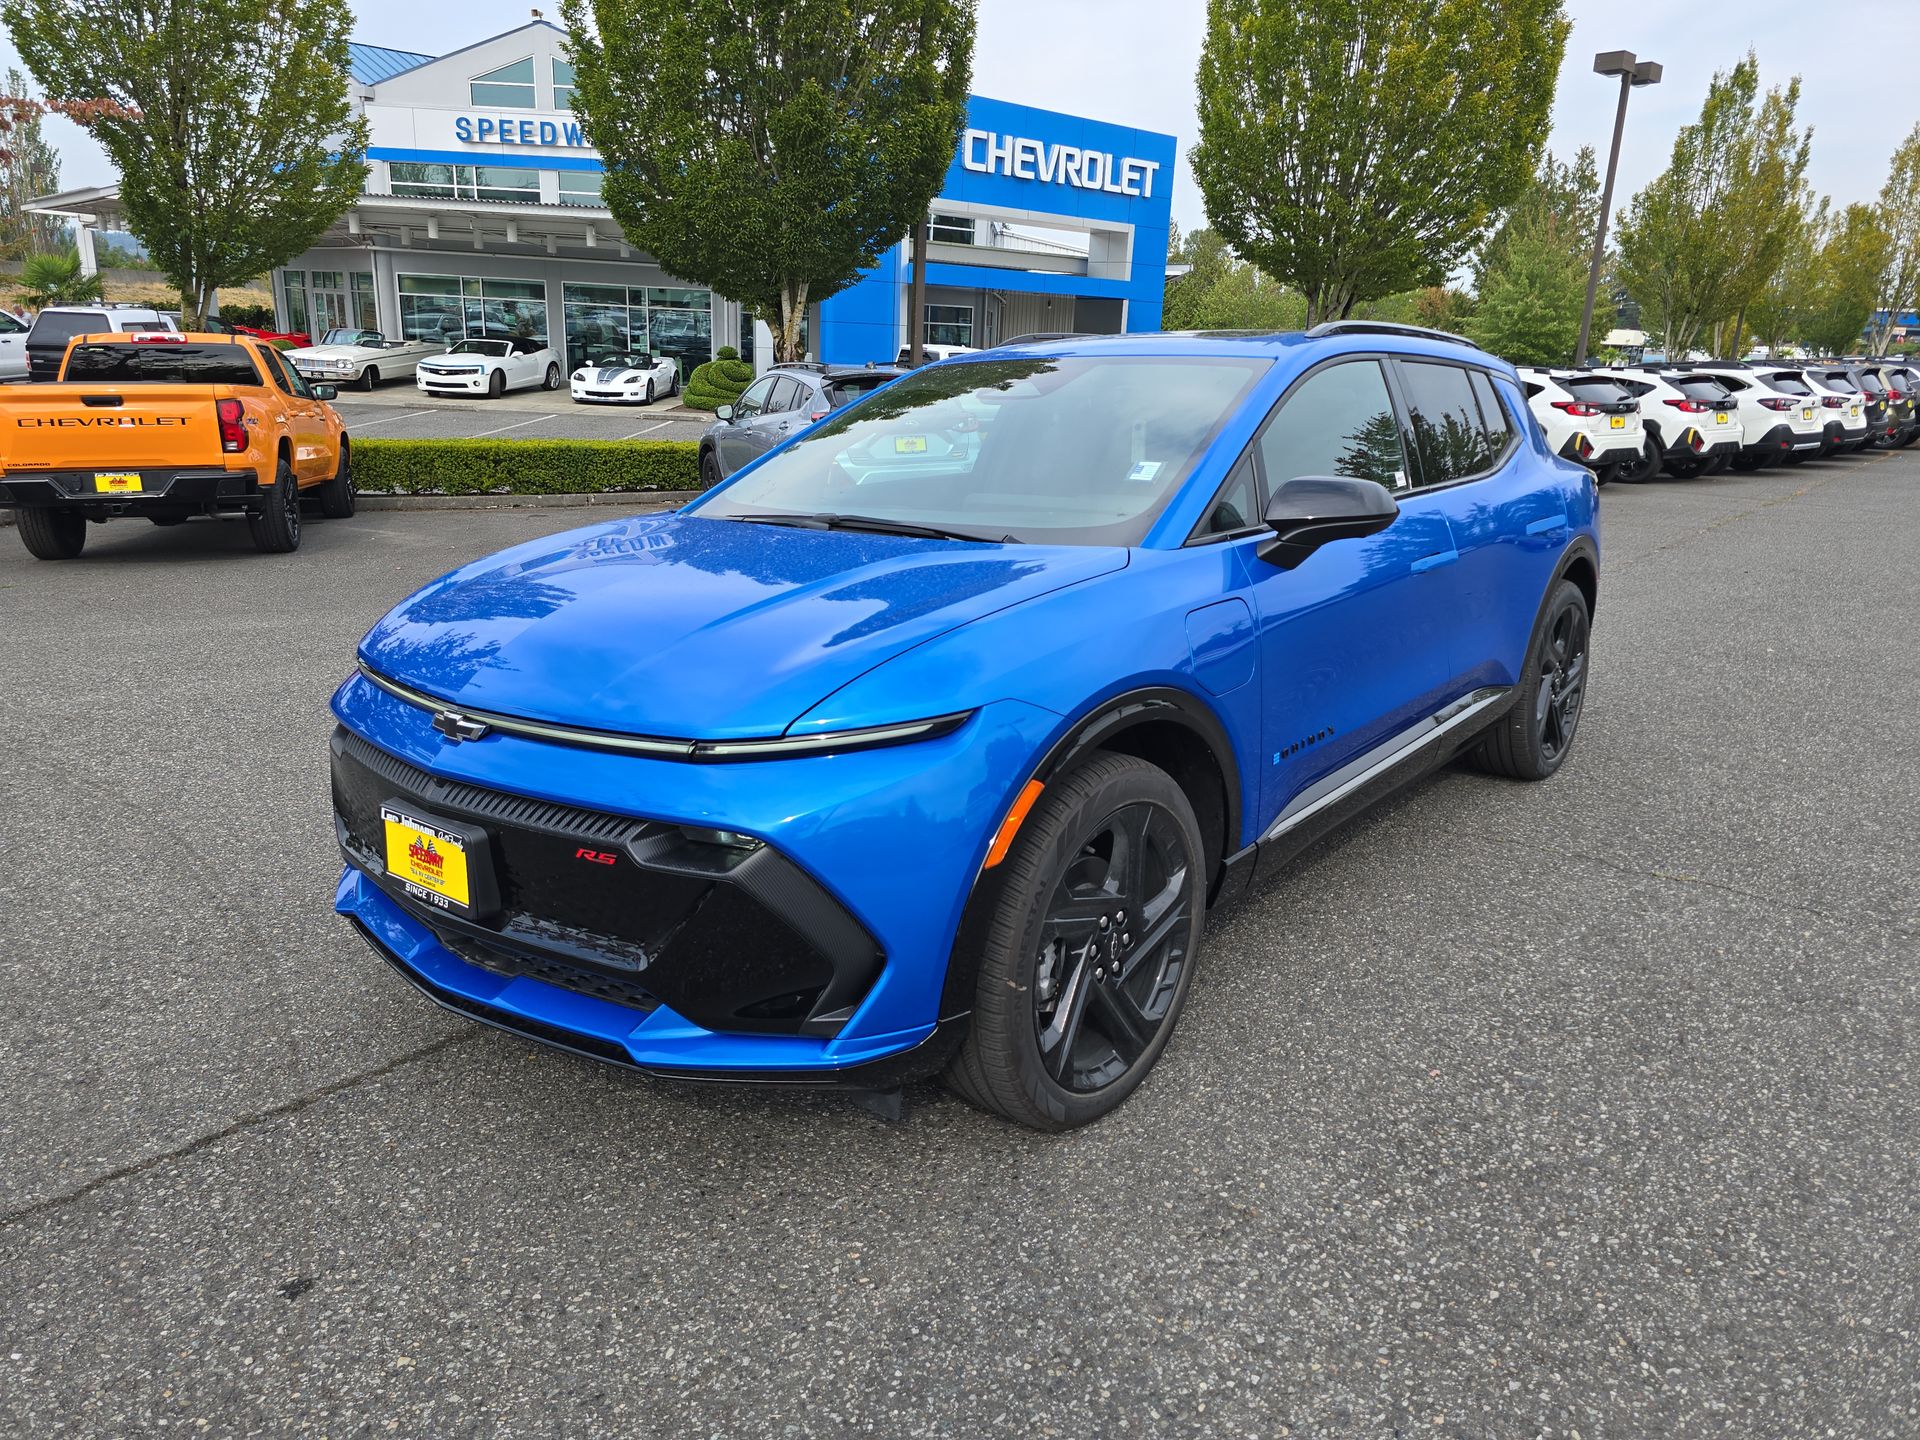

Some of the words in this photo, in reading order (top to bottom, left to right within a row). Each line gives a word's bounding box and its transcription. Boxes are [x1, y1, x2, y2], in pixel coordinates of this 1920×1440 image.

[963, 128, 1160, 198] CHEVROLET
[17, 417, 192, 427] CHEVROLET
[575, 848, 618, 865] RS
[410, 859, 443, 878] CHEVROLET
[405, 883, 427, 899] SINCE
[430, 894, 449, 908] 1933
